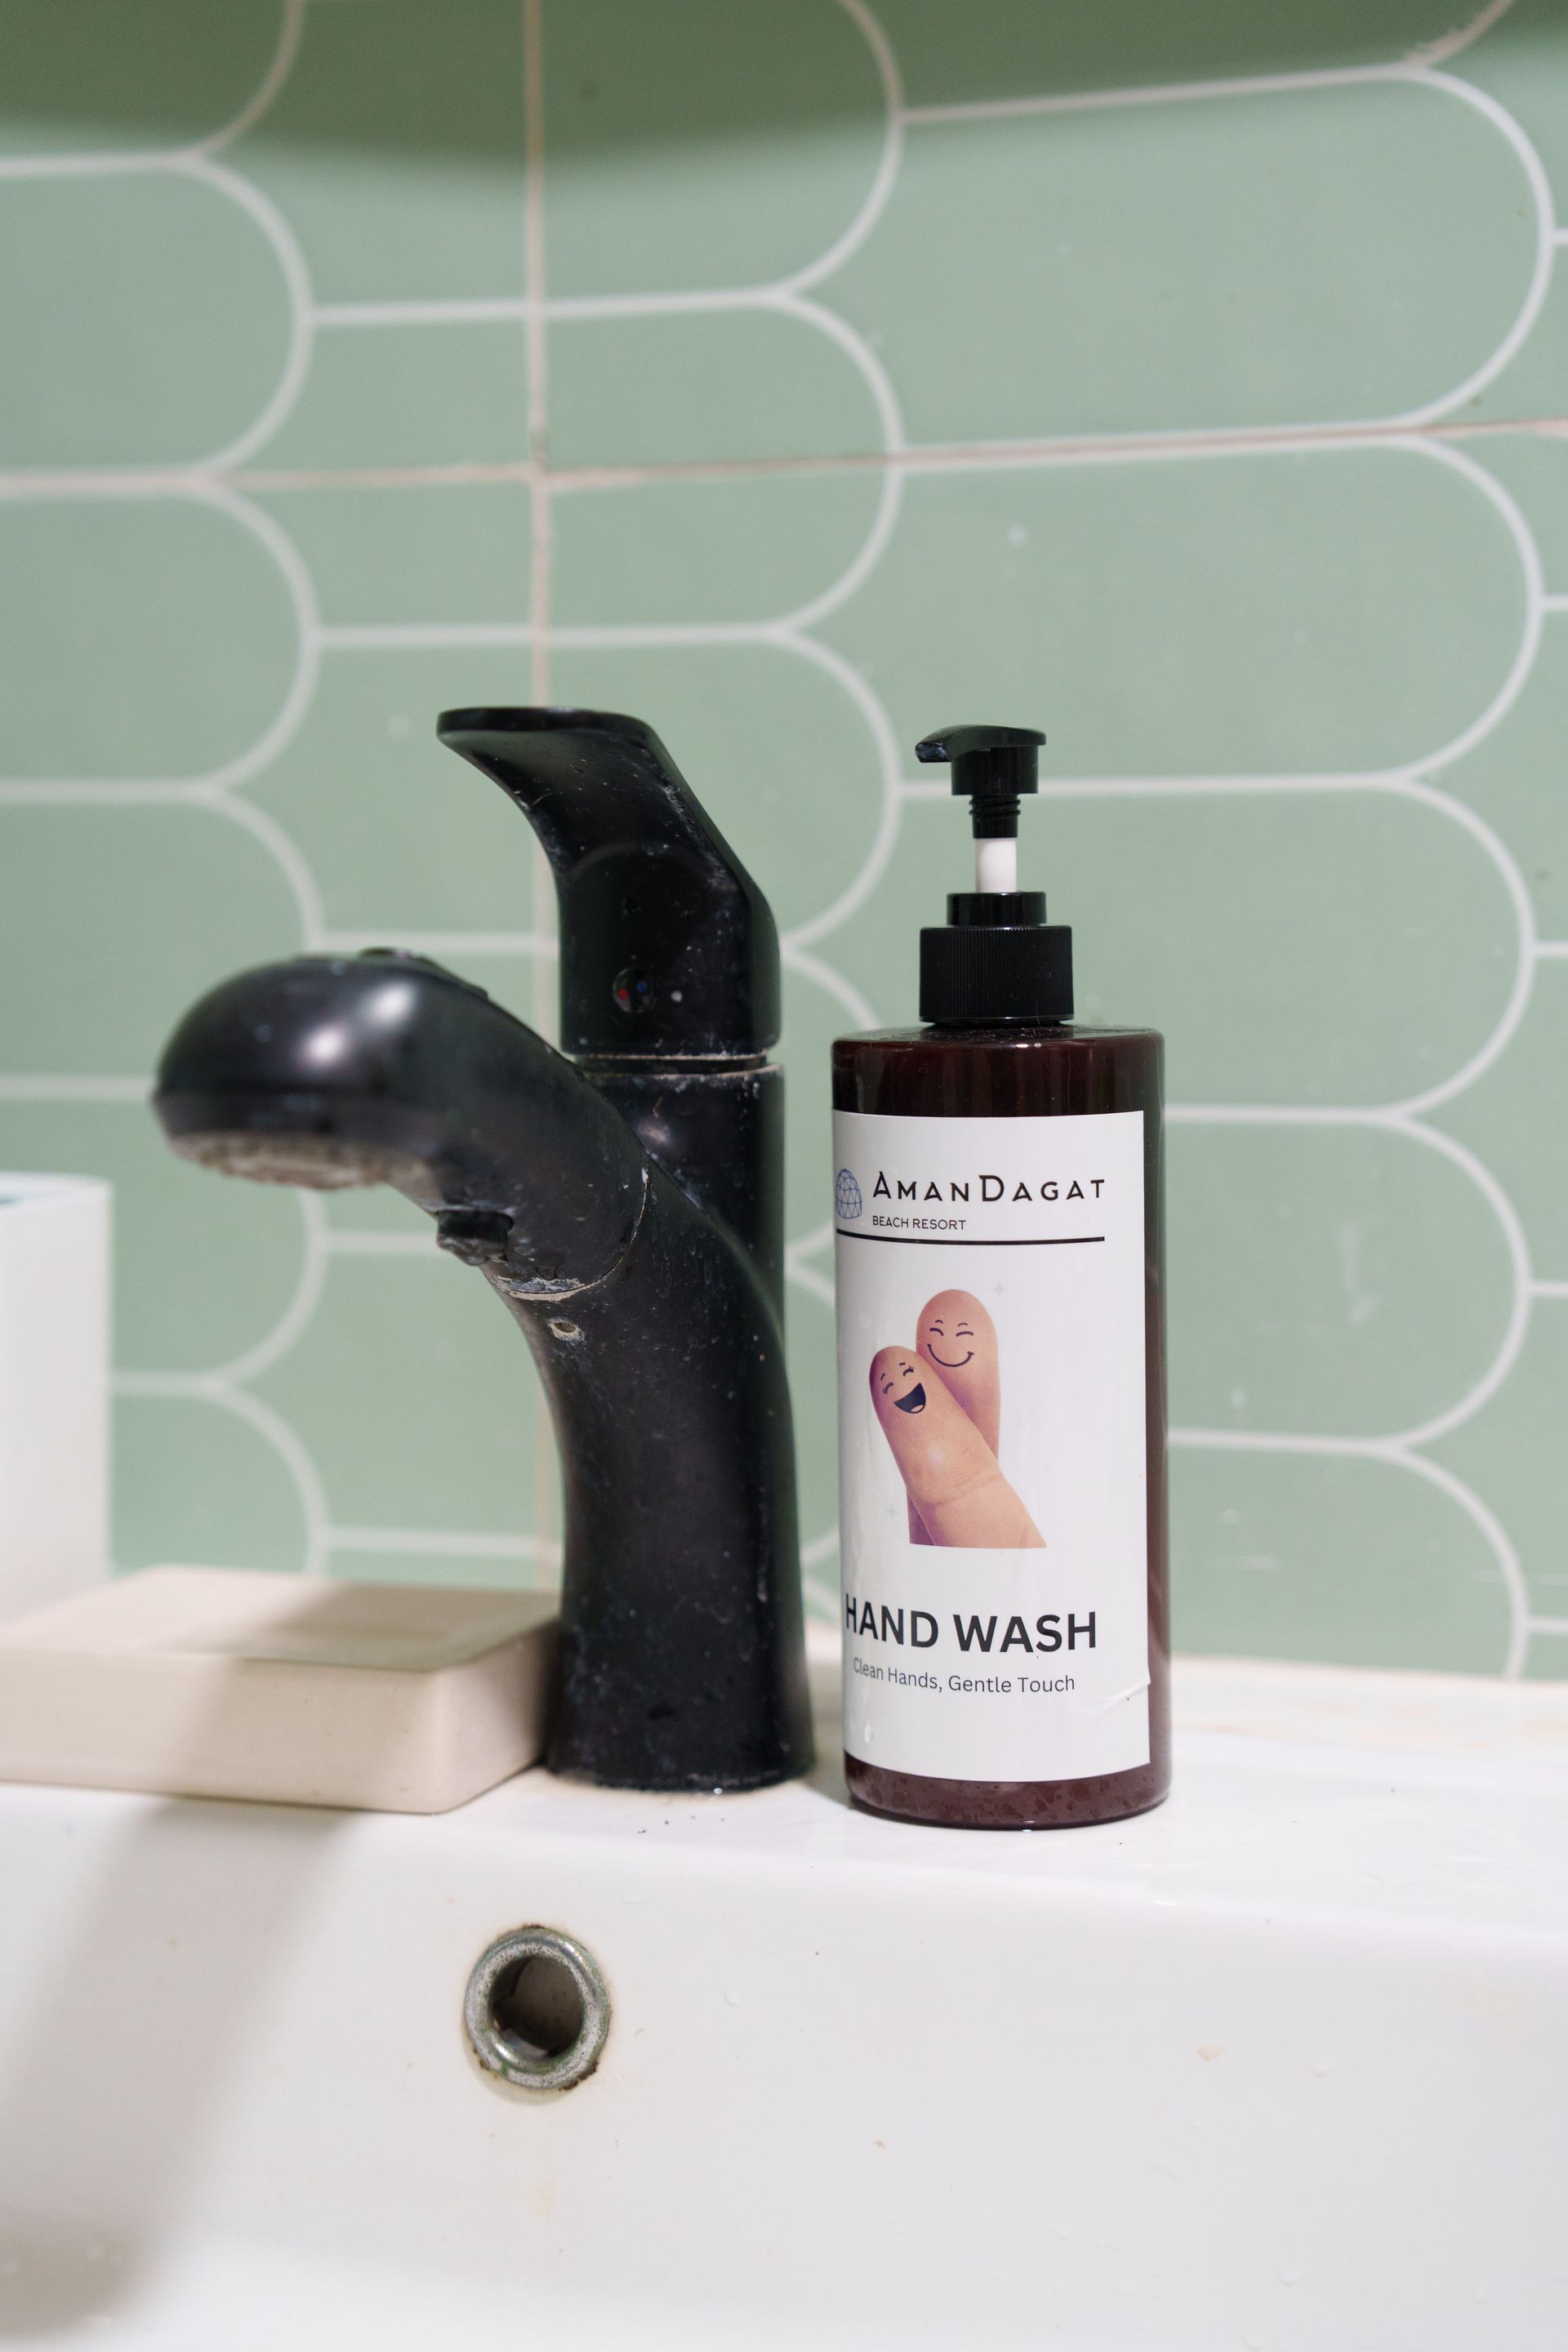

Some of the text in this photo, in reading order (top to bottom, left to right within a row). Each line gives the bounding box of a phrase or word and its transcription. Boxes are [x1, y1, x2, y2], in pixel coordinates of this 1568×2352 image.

[872, 1215, 967, 1231] BEACH RESORT
[845, 1592, 1096, 1653] HAND WASH
[853, 1657, 1075, 1693] Clean Hands, Gentle Touch
